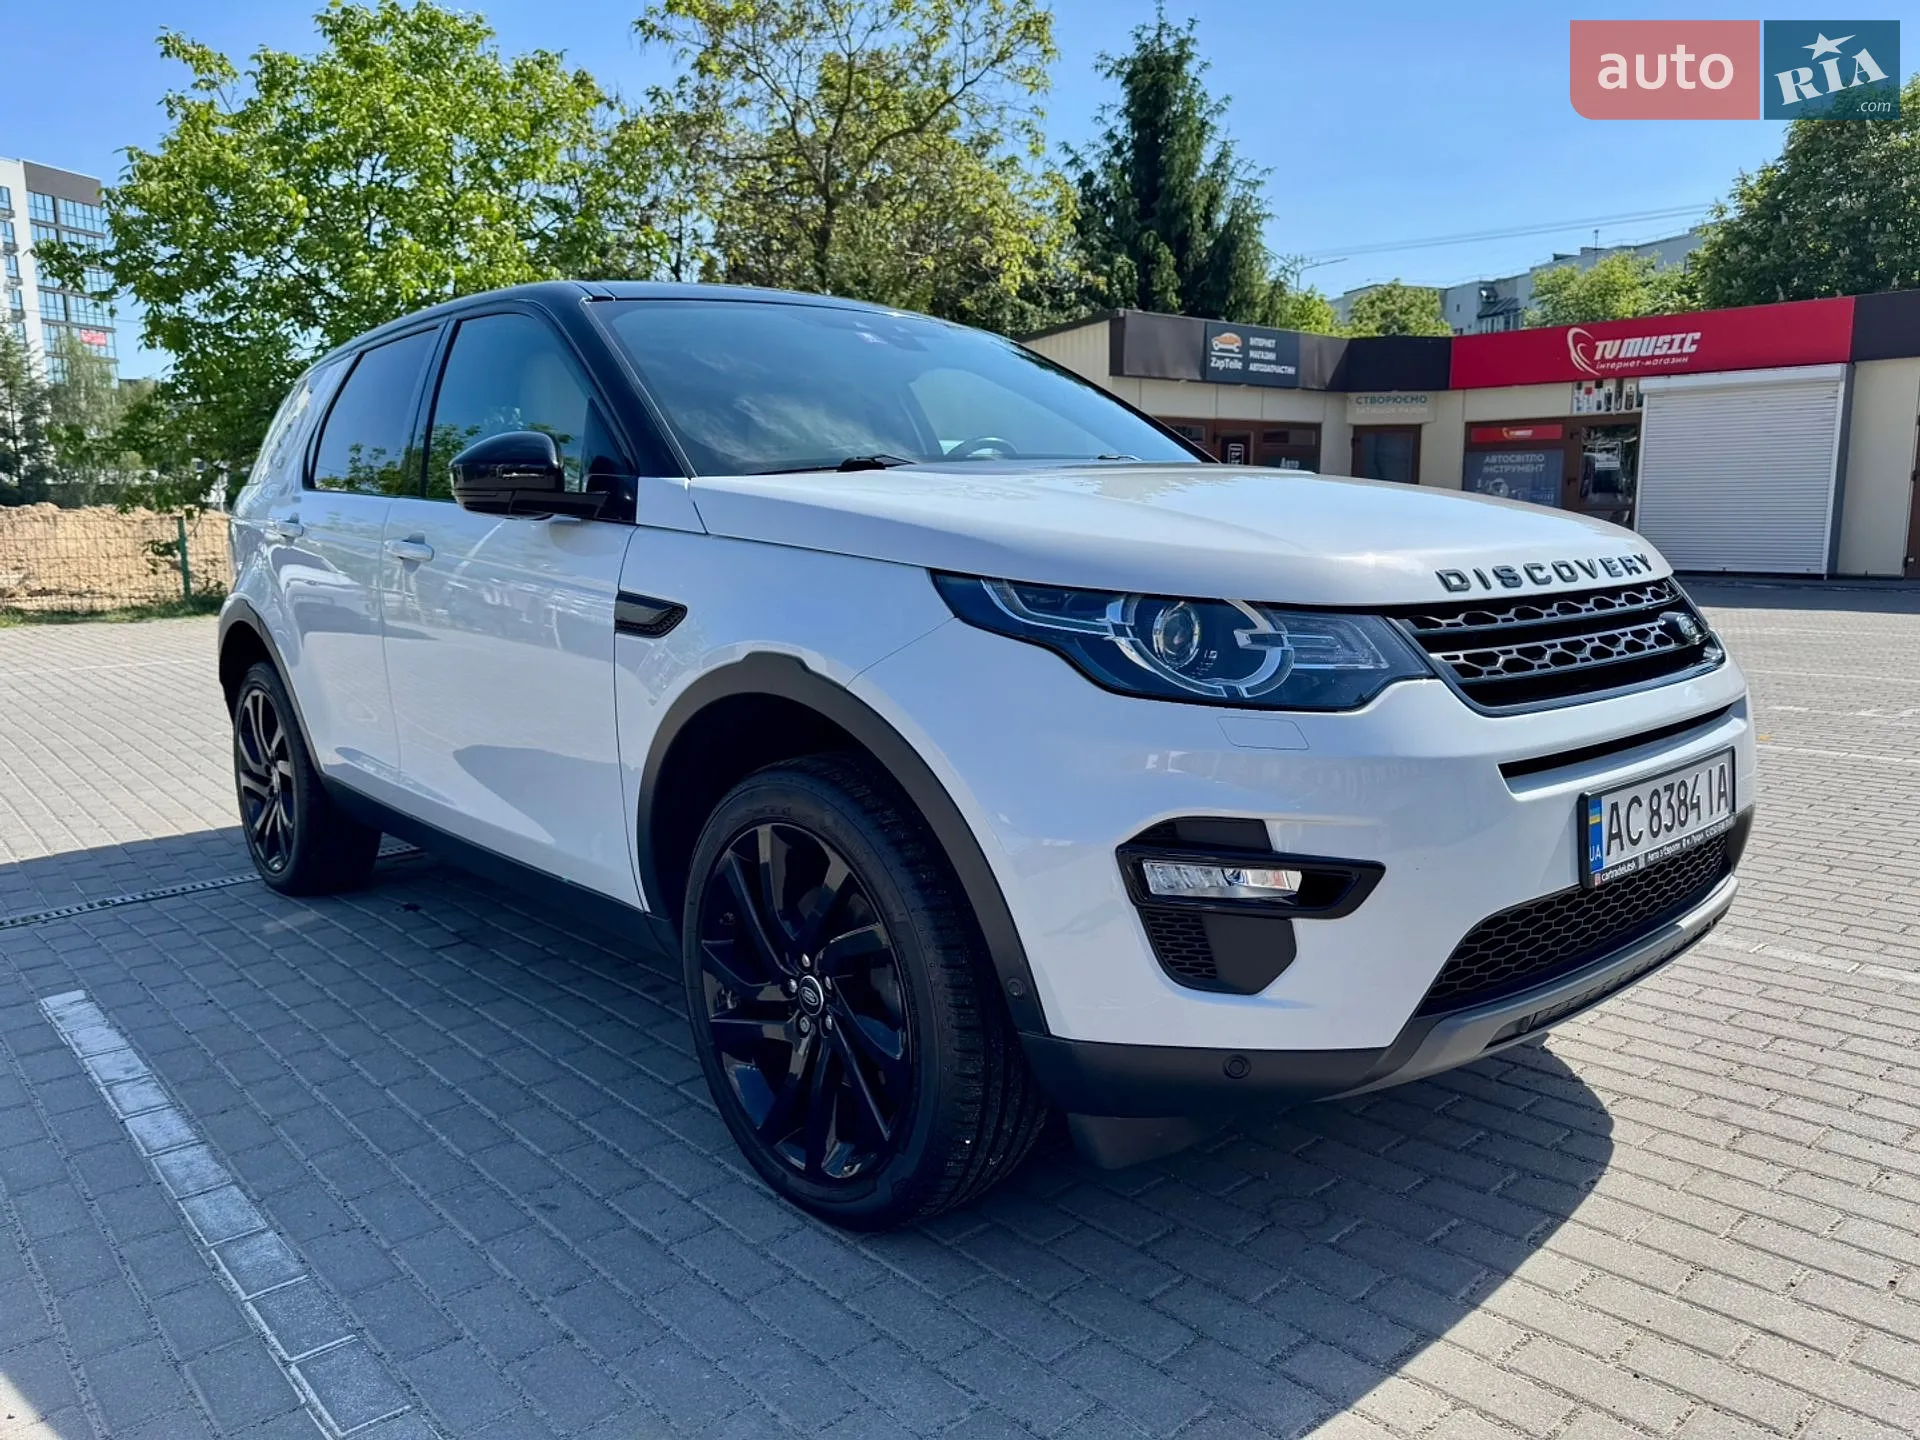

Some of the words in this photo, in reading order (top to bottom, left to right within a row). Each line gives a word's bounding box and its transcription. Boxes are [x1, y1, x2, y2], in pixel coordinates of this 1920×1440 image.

[1436, 553, 1653, 592] DISCOVERY
[1606, 795, 1644, 856] AC
[1649, 773, 1701, 839] 8384
[1708, 763, 1729, 816] IA
[1589, 845, 1601, 861] UA
